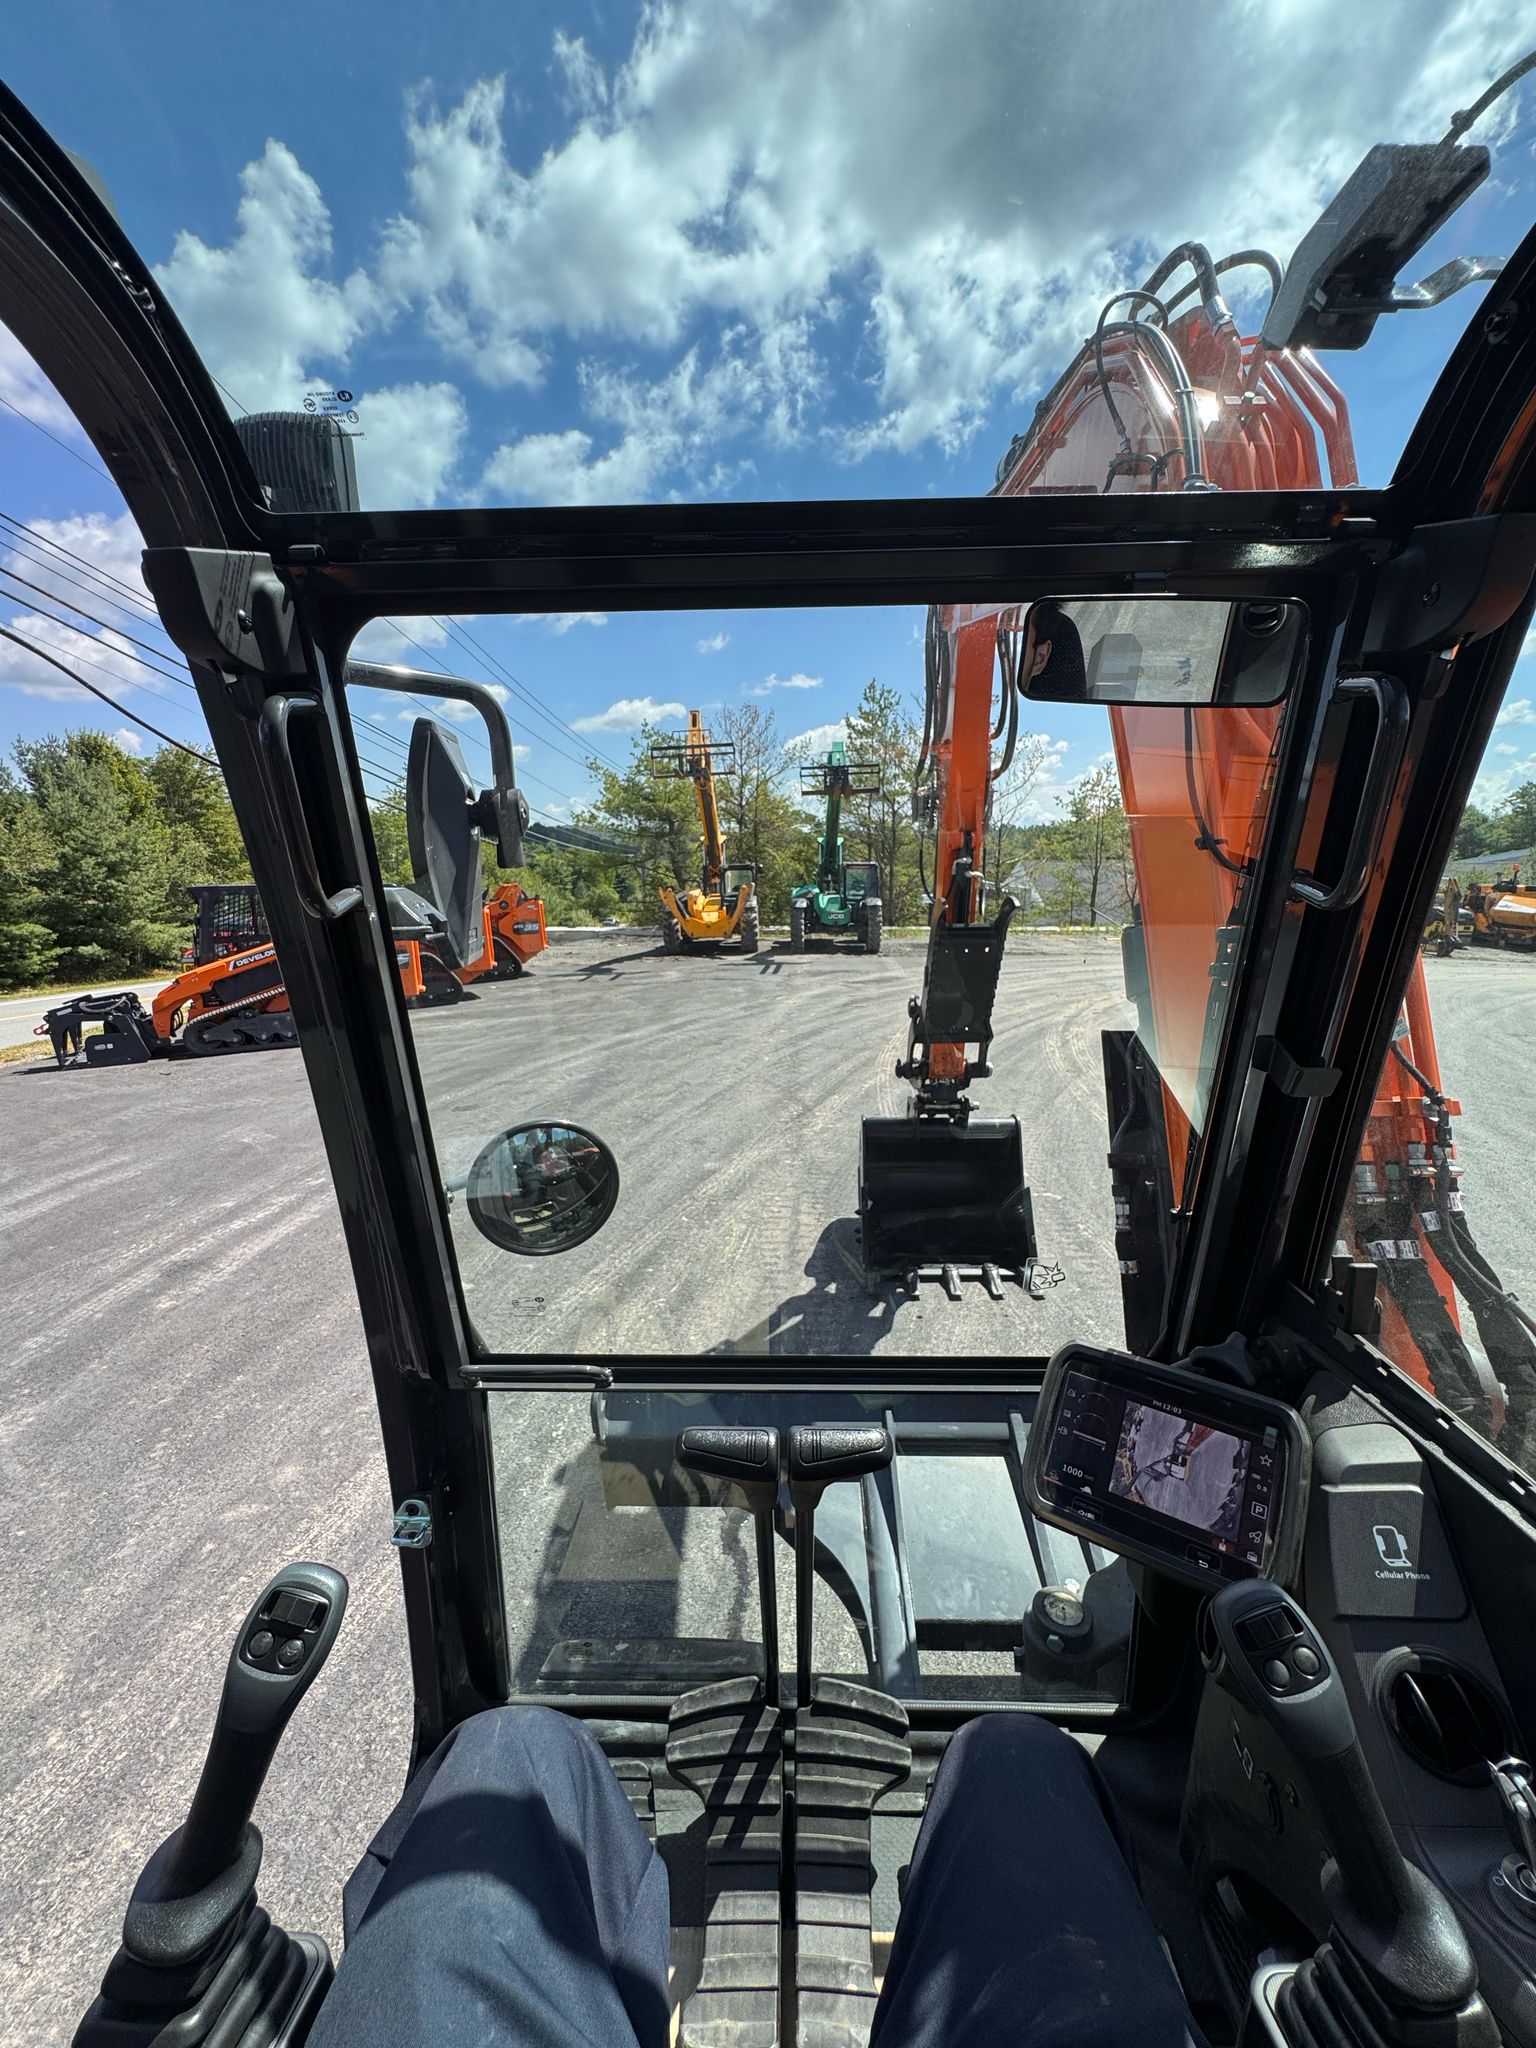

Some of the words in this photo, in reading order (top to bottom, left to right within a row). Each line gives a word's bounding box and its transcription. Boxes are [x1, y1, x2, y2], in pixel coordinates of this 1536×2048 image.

[1162, 1403, 1182, 1414] 12:03
[1062, 1464, 1084, 1478] 1000
[1374, 1570, 1405, 1580] Cellular
[1405, 1571, 1431, 1580] Phone
